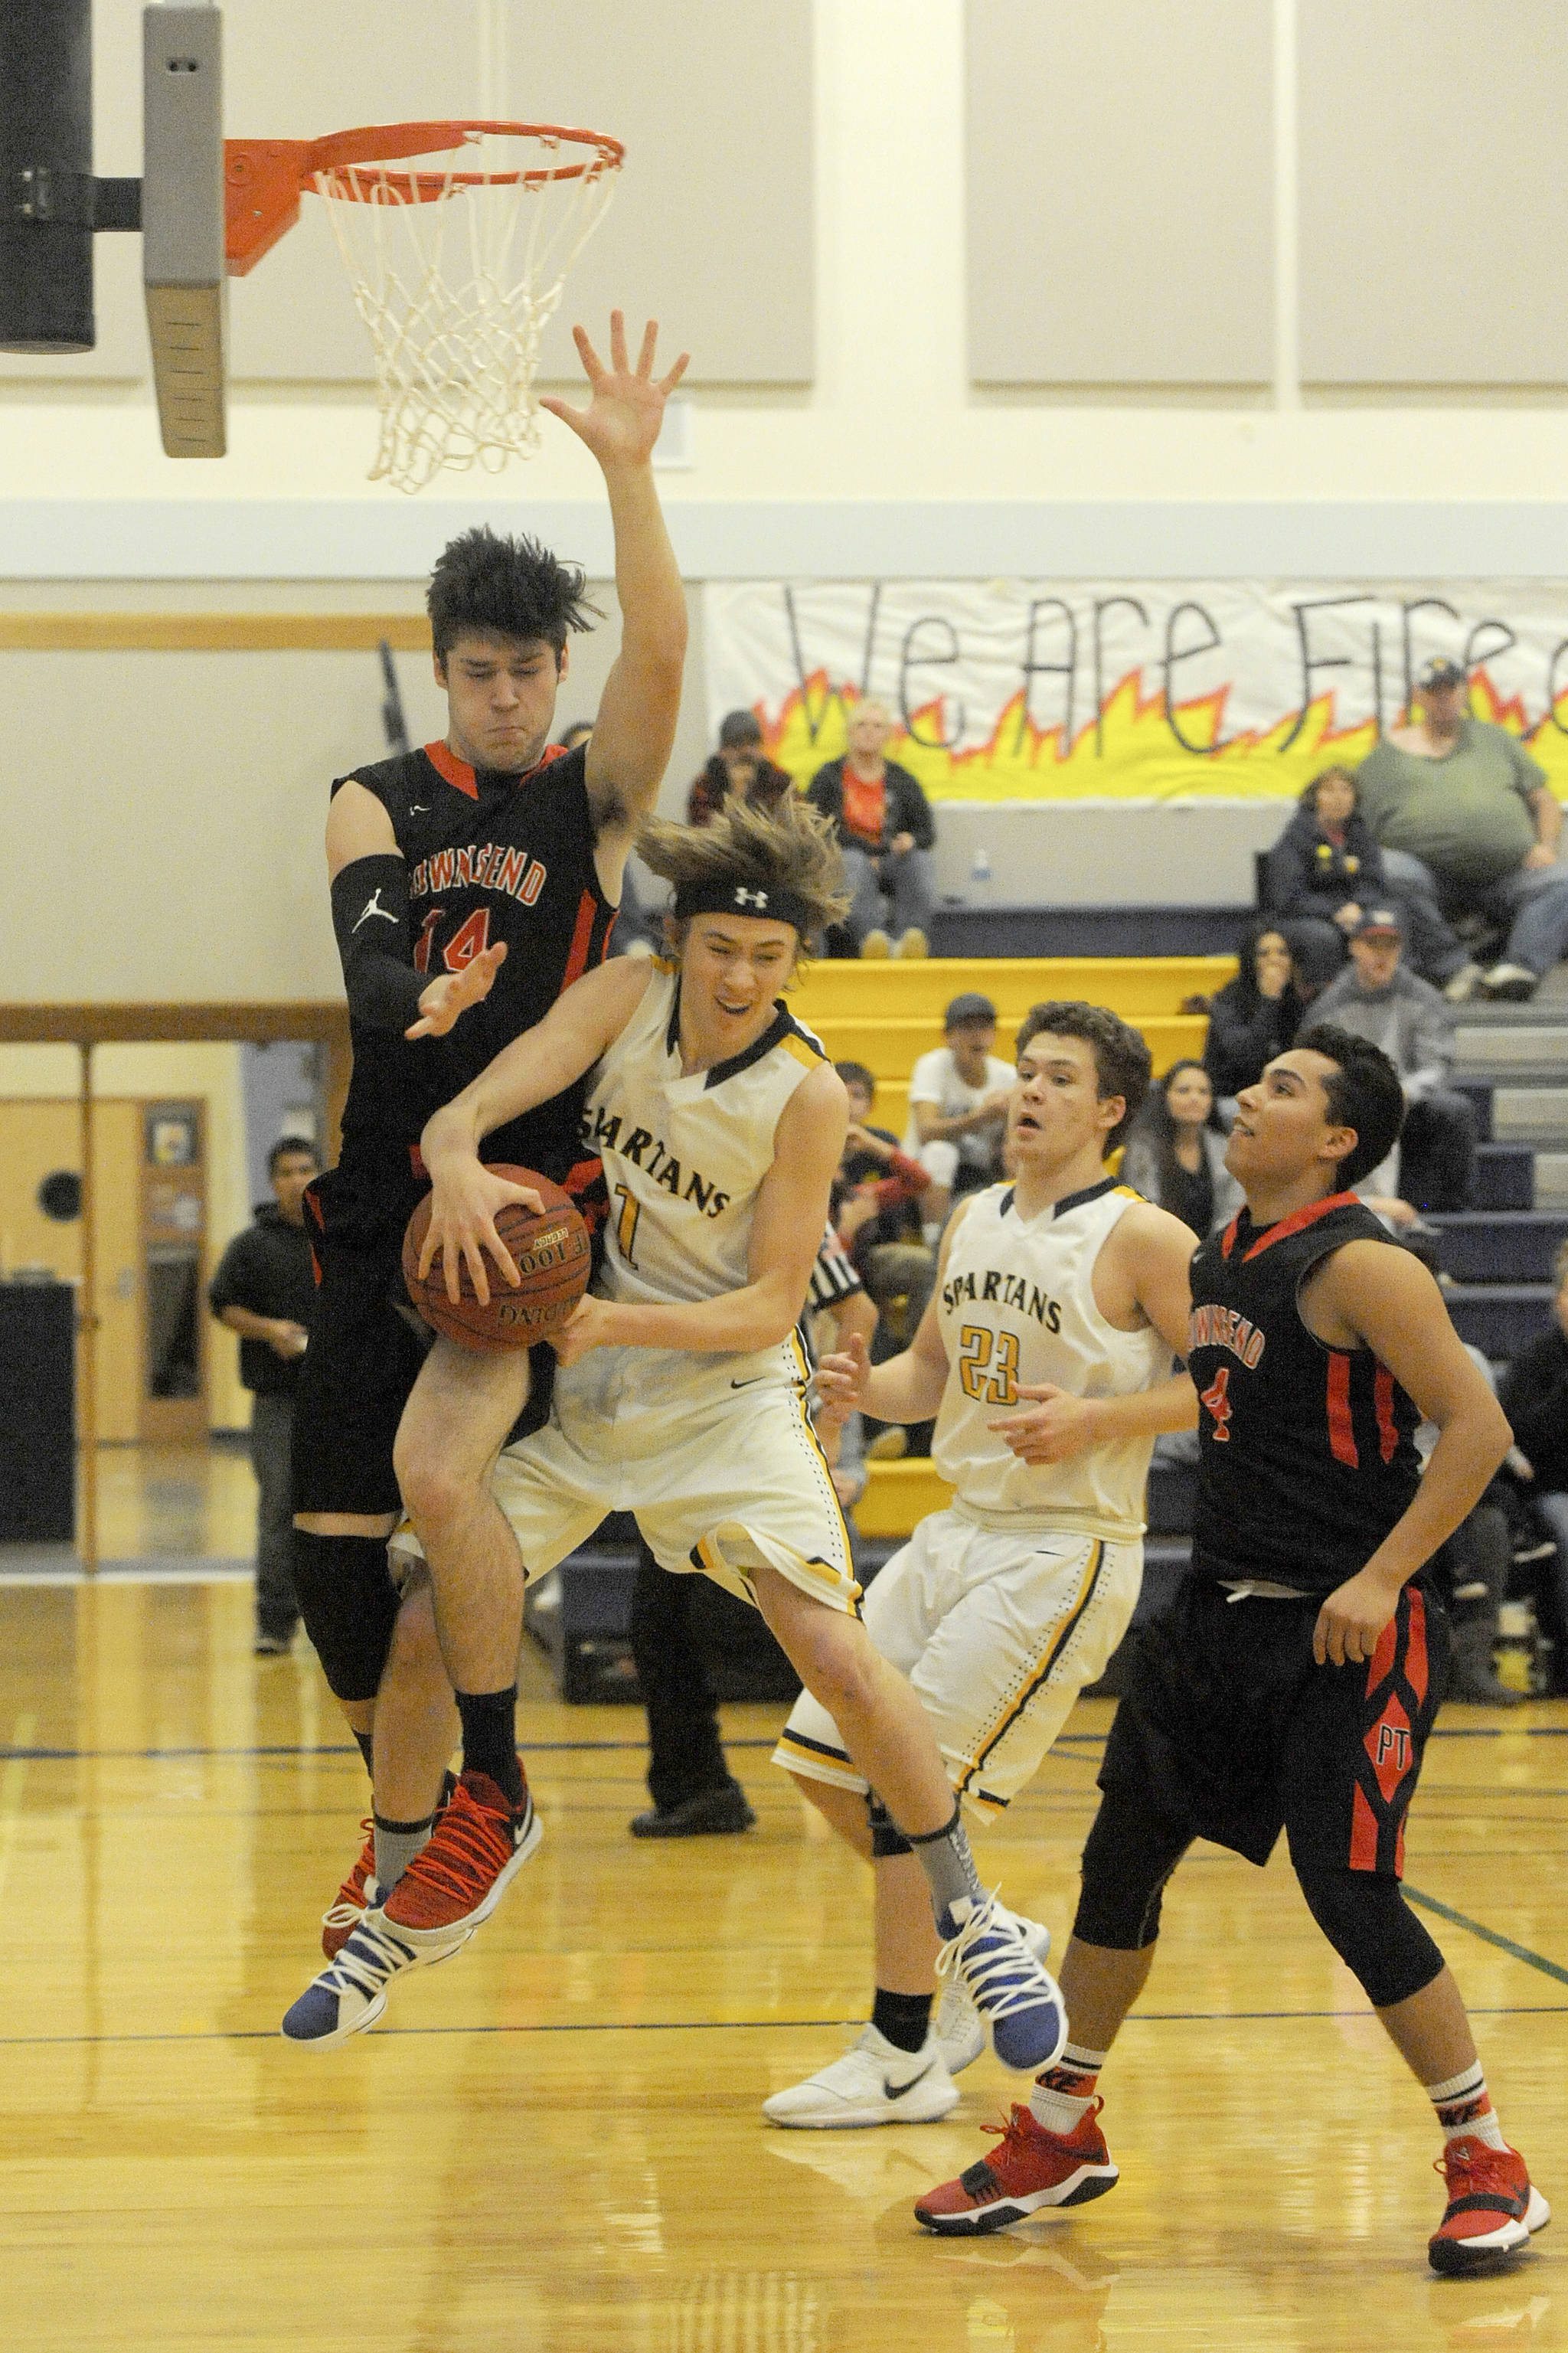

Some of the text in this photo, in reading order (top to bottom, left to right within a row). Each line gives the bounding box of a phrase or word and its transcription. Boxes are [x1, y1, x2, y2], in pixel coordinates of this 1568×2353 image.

[782, 583, 1568, 756] We Are Fire
[410, 843, 547, 907] OWNSEND
[413, 907, 491, 974] 14
[532, 1227, 569, 1250] LEGACY
[615, 1182, 640, 1271] 1
[943, 1270, 1063, 1335] SPARTANS
[960, 1324, 1021, 1407] 23
[1377, 1723, 1410, 1771] PT
